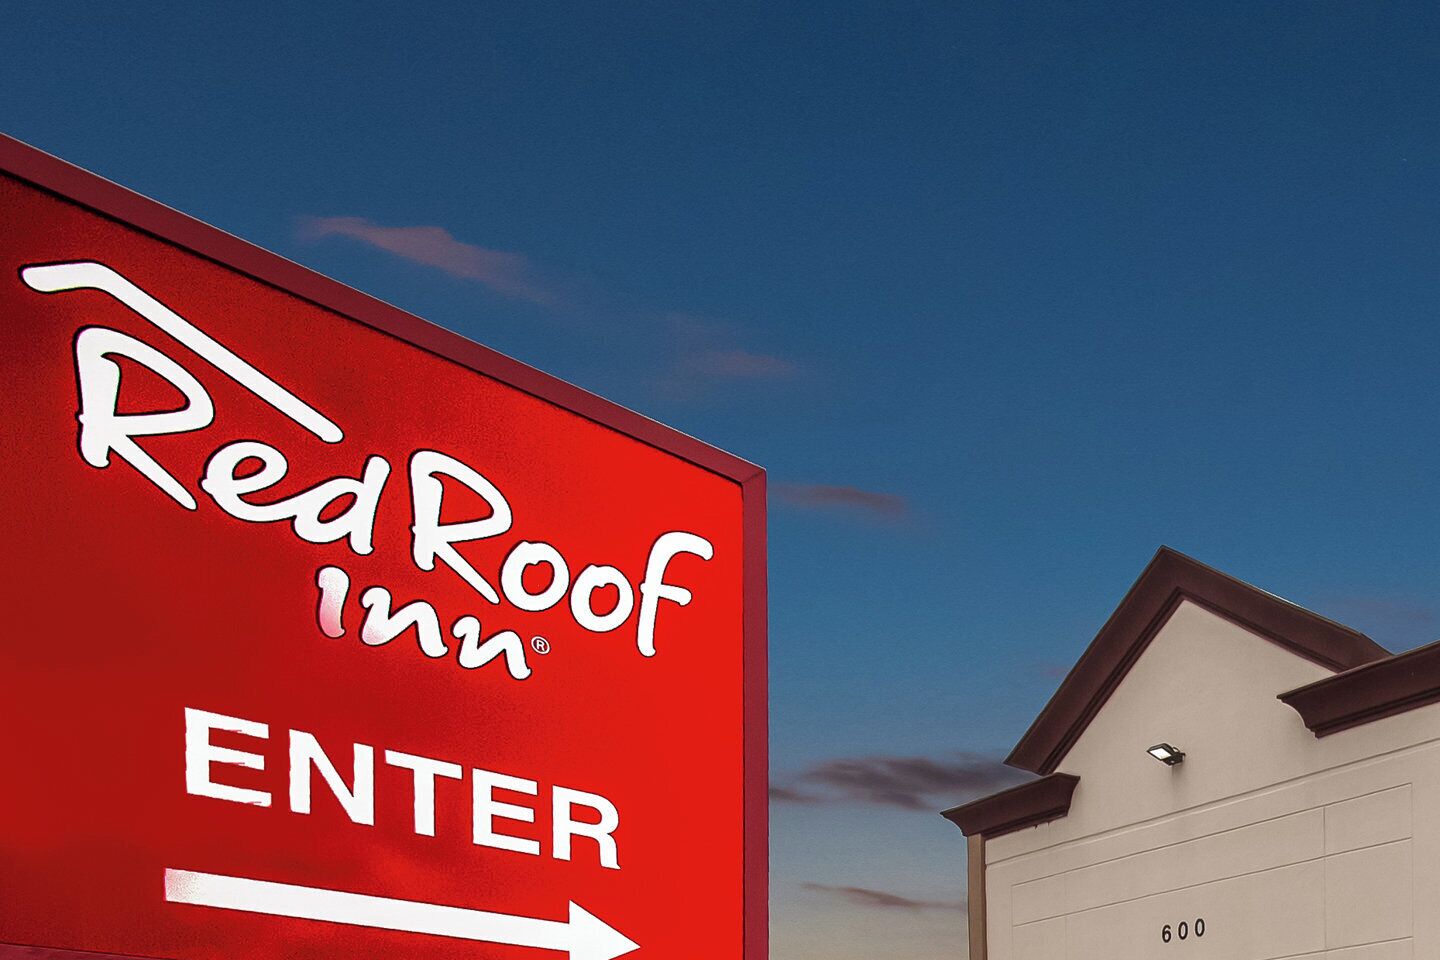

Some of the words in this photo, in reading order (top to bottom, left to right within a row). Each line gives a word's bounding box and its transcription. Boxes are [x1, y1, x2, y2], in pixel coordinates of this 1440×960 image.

[76, 326, 391, 556] Red
[409, 449, 714, 657] Roof
[184, 706, 621, 870] ENTER
[1162, 918, 1205, 943] 600
